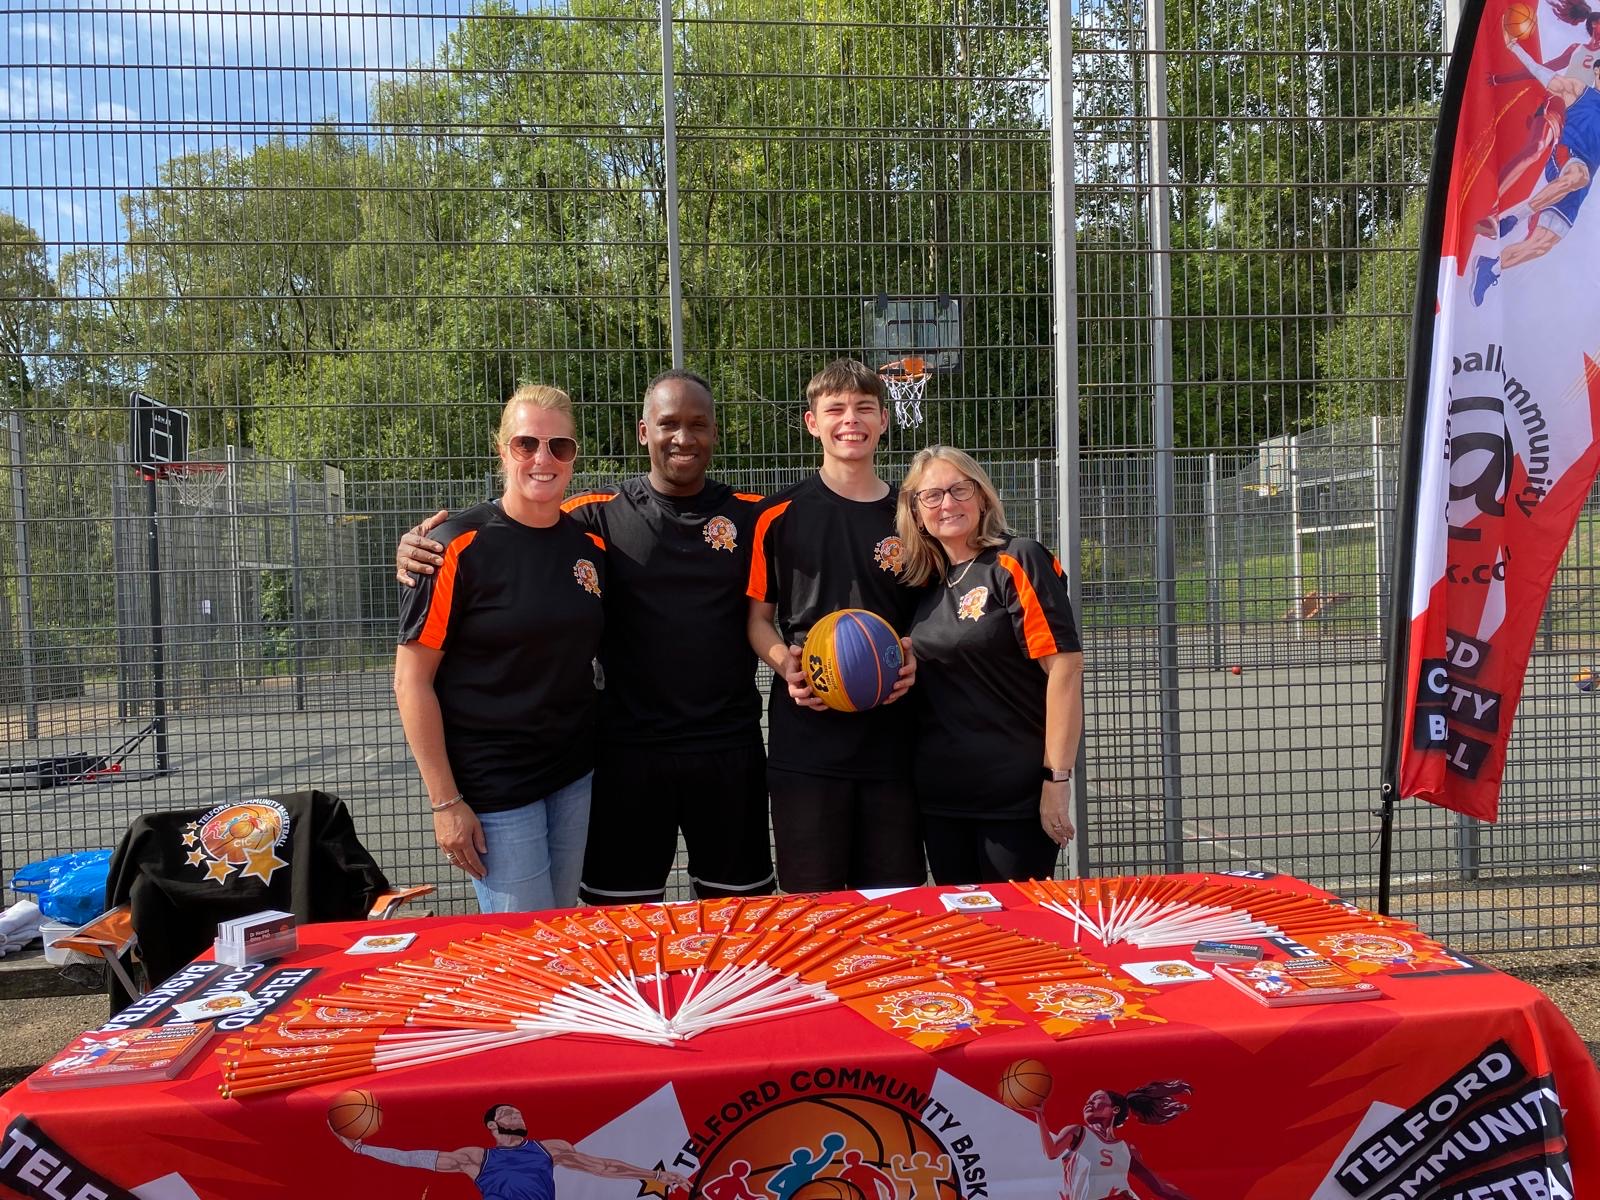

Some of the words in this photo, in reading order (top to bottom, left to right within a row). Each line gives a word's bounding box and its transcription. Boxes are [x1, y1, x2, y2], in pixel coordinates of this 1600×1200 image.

[198, 803, 231, 825] TELFORD
[672, 1079, 781, 1171] TELFORD
[790, 1066, 962, 1134] COMMUNITY
[1340, 1052, 1512, 1185] TELFORD
[1099, 1149, 1113, 1166] S
